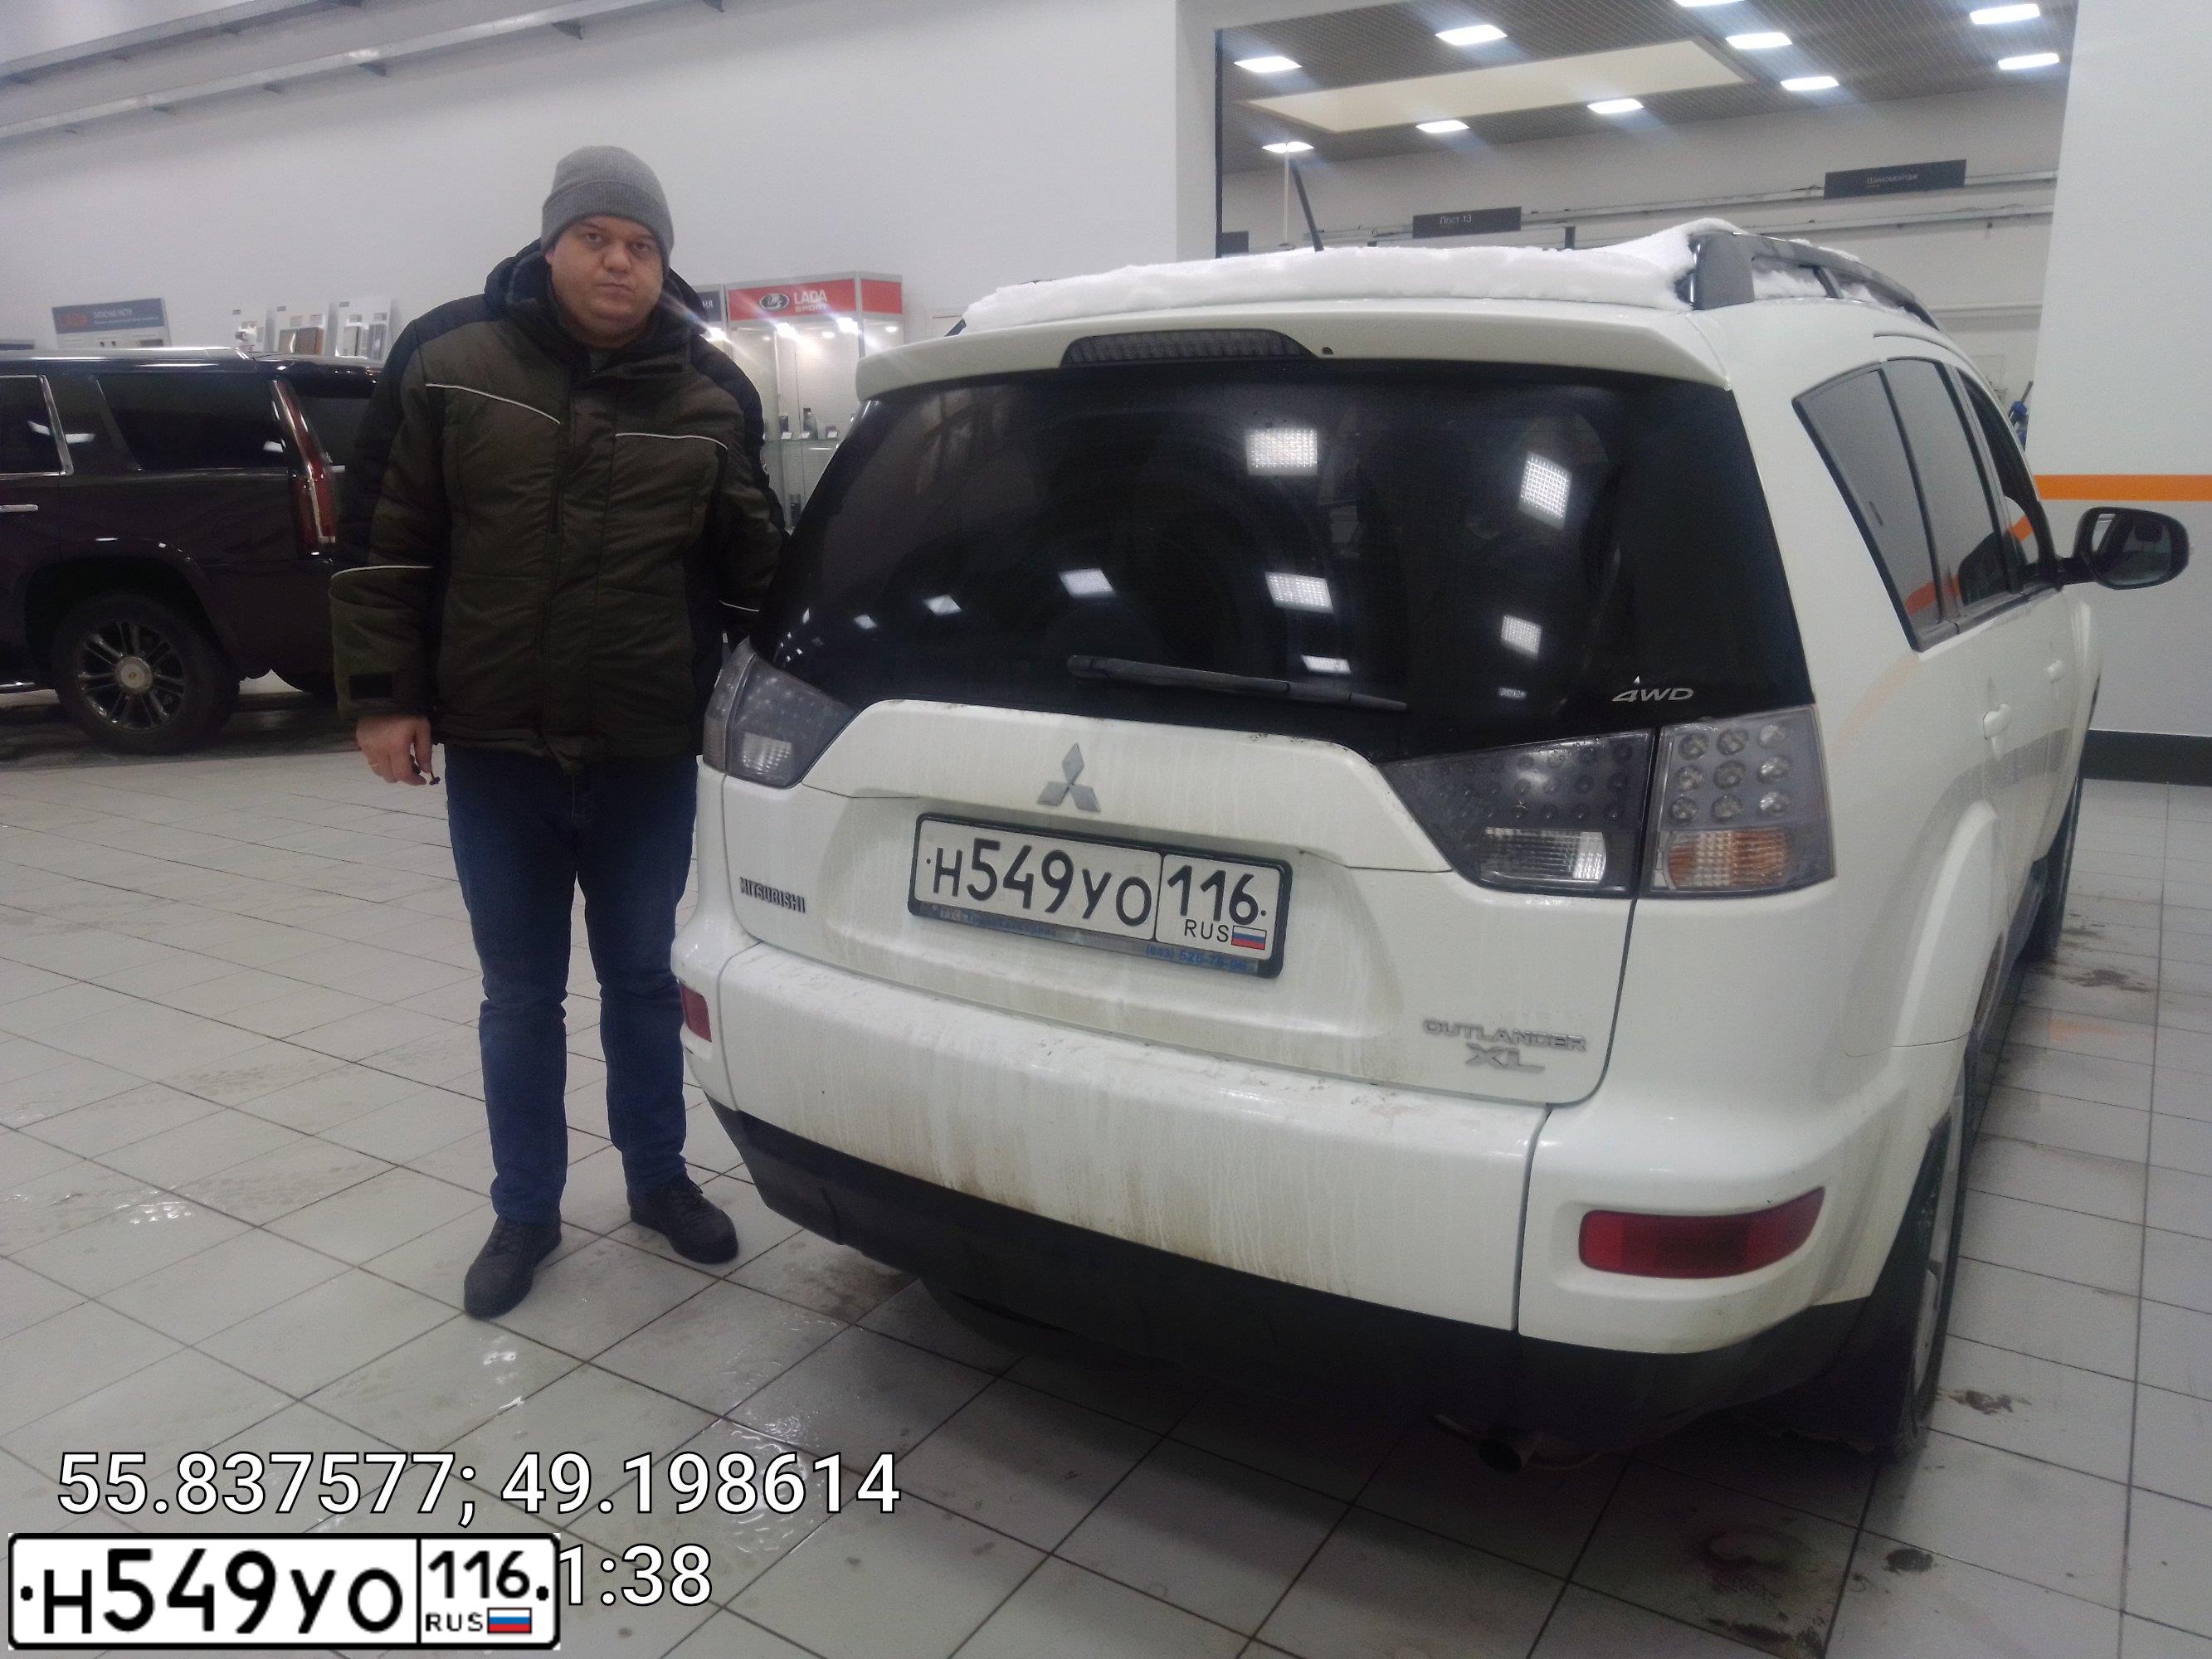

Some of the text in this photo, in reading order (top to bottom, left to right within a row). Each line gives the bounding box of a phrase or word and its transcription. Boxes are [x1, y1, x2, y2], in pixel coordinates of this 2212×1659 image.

[1440, 216, 1460, 225] Пост
[793, 289, 828, 305] LADA
[1612, 688, 1694, 703] 4WD
[739, 876, 806, 914] MITSUBISHI
[933, 837, 1260, 927] Н549УО 116
[1183, 918, 1230, 943] RUS
[1423, 1019, 1588, 1053] OUTLANDER
[1464, 1042, 1547, 1076] XL
